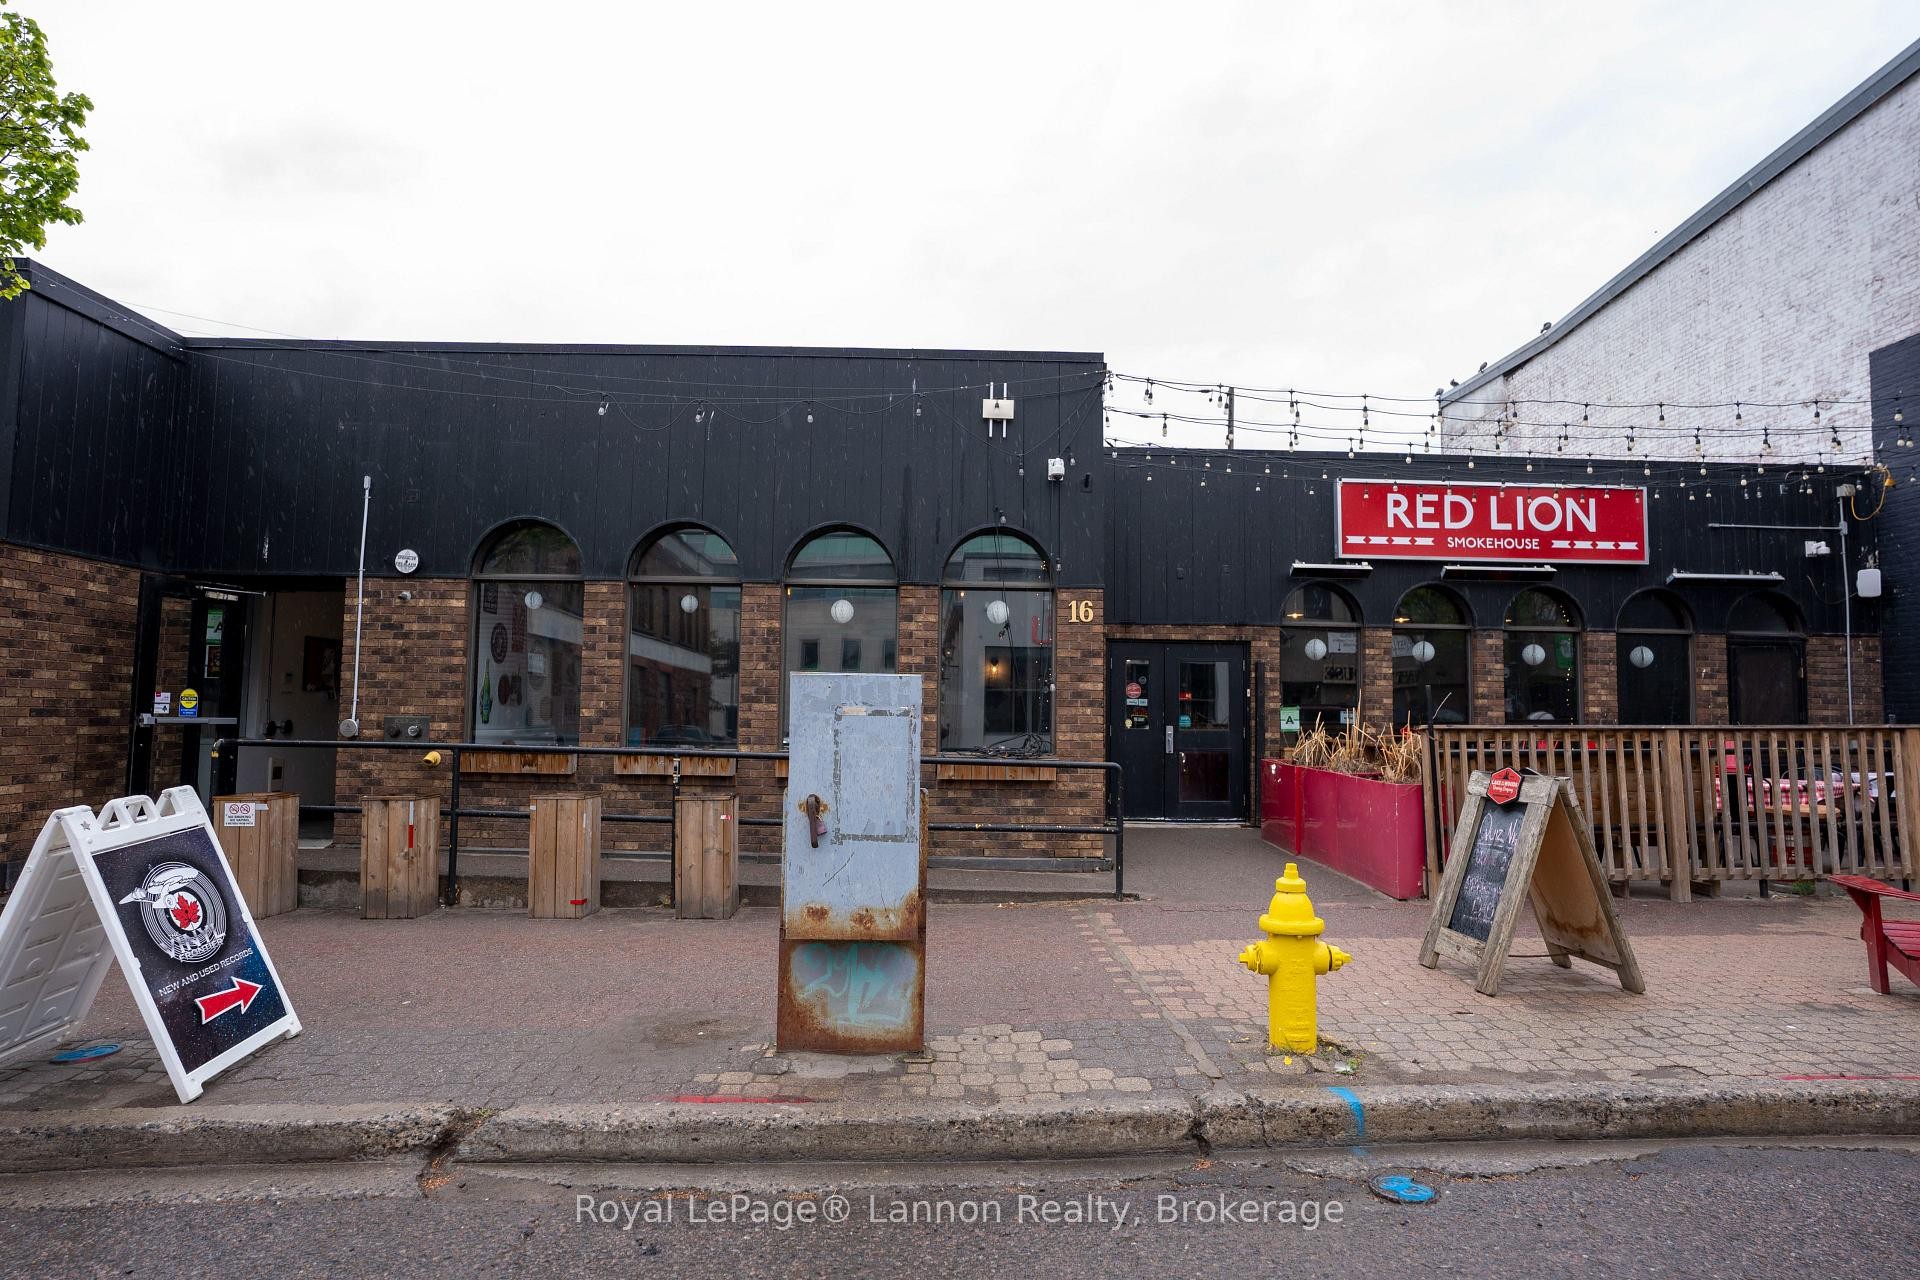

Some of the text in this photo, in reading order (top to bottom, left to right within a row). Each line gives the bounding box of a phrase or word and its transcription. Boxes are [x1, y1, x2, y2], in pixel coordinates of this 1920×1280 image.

[1386, 493, 1596, 533] RED LION
[1447, 537, 1540, 550] SMOKEHOUSE
[1068, 600, 1094, 623] 16
[1285, 715, 1295, 725] A
[177, 937, 224, 963] FRONTIER
[158, 947, 253, 996] NEW AND USED RECORDS
